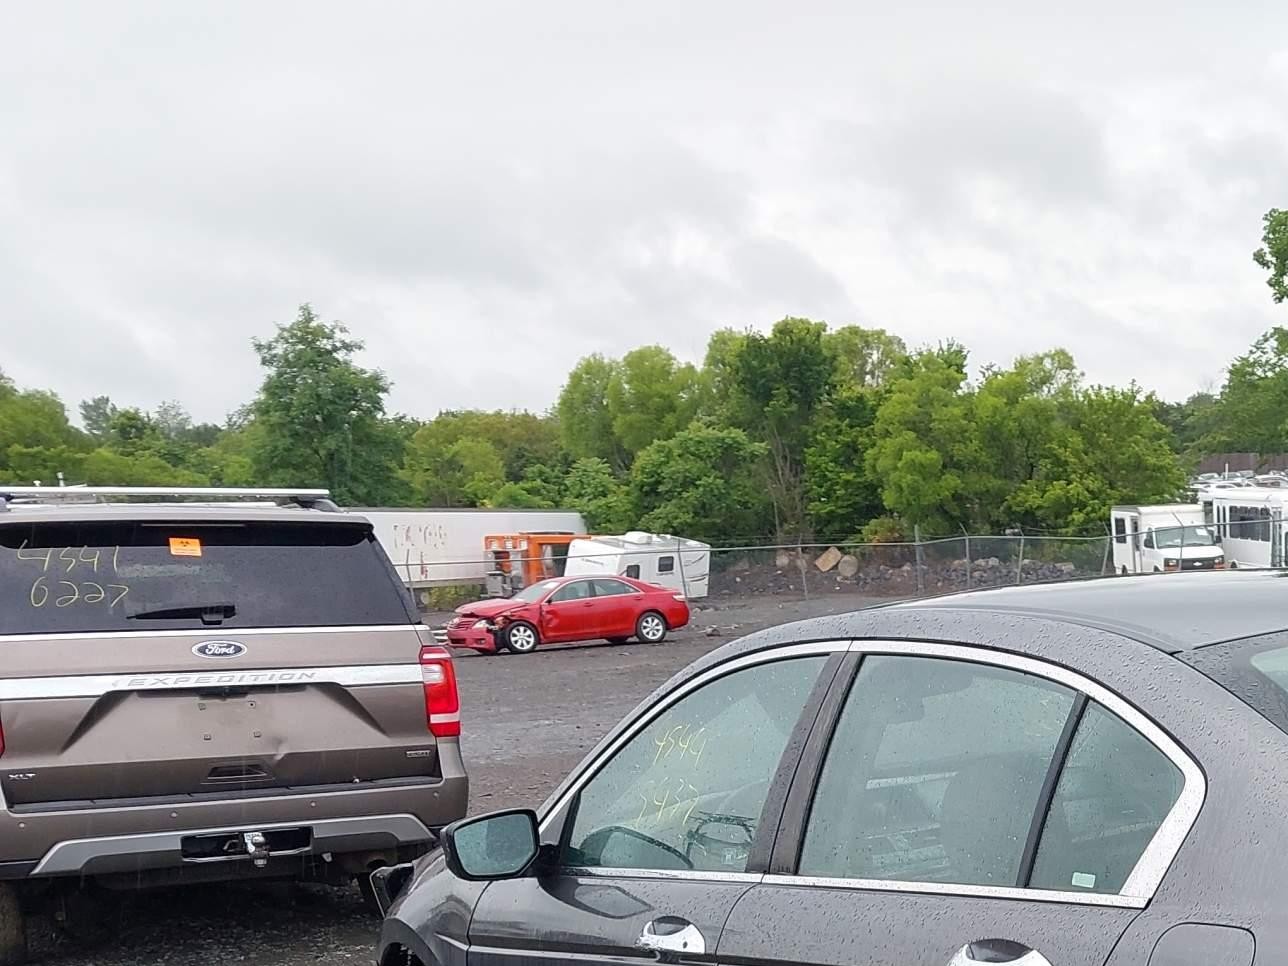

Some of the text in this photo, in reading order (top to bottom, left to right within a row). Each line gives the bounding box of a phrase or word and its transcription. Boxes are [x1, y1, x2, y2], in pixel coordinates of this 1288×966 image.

[17, 539, 120, 573] 4541
[31, 576, 129, 608] 6227
[127, 672, 316, 687] EXPEDITION
